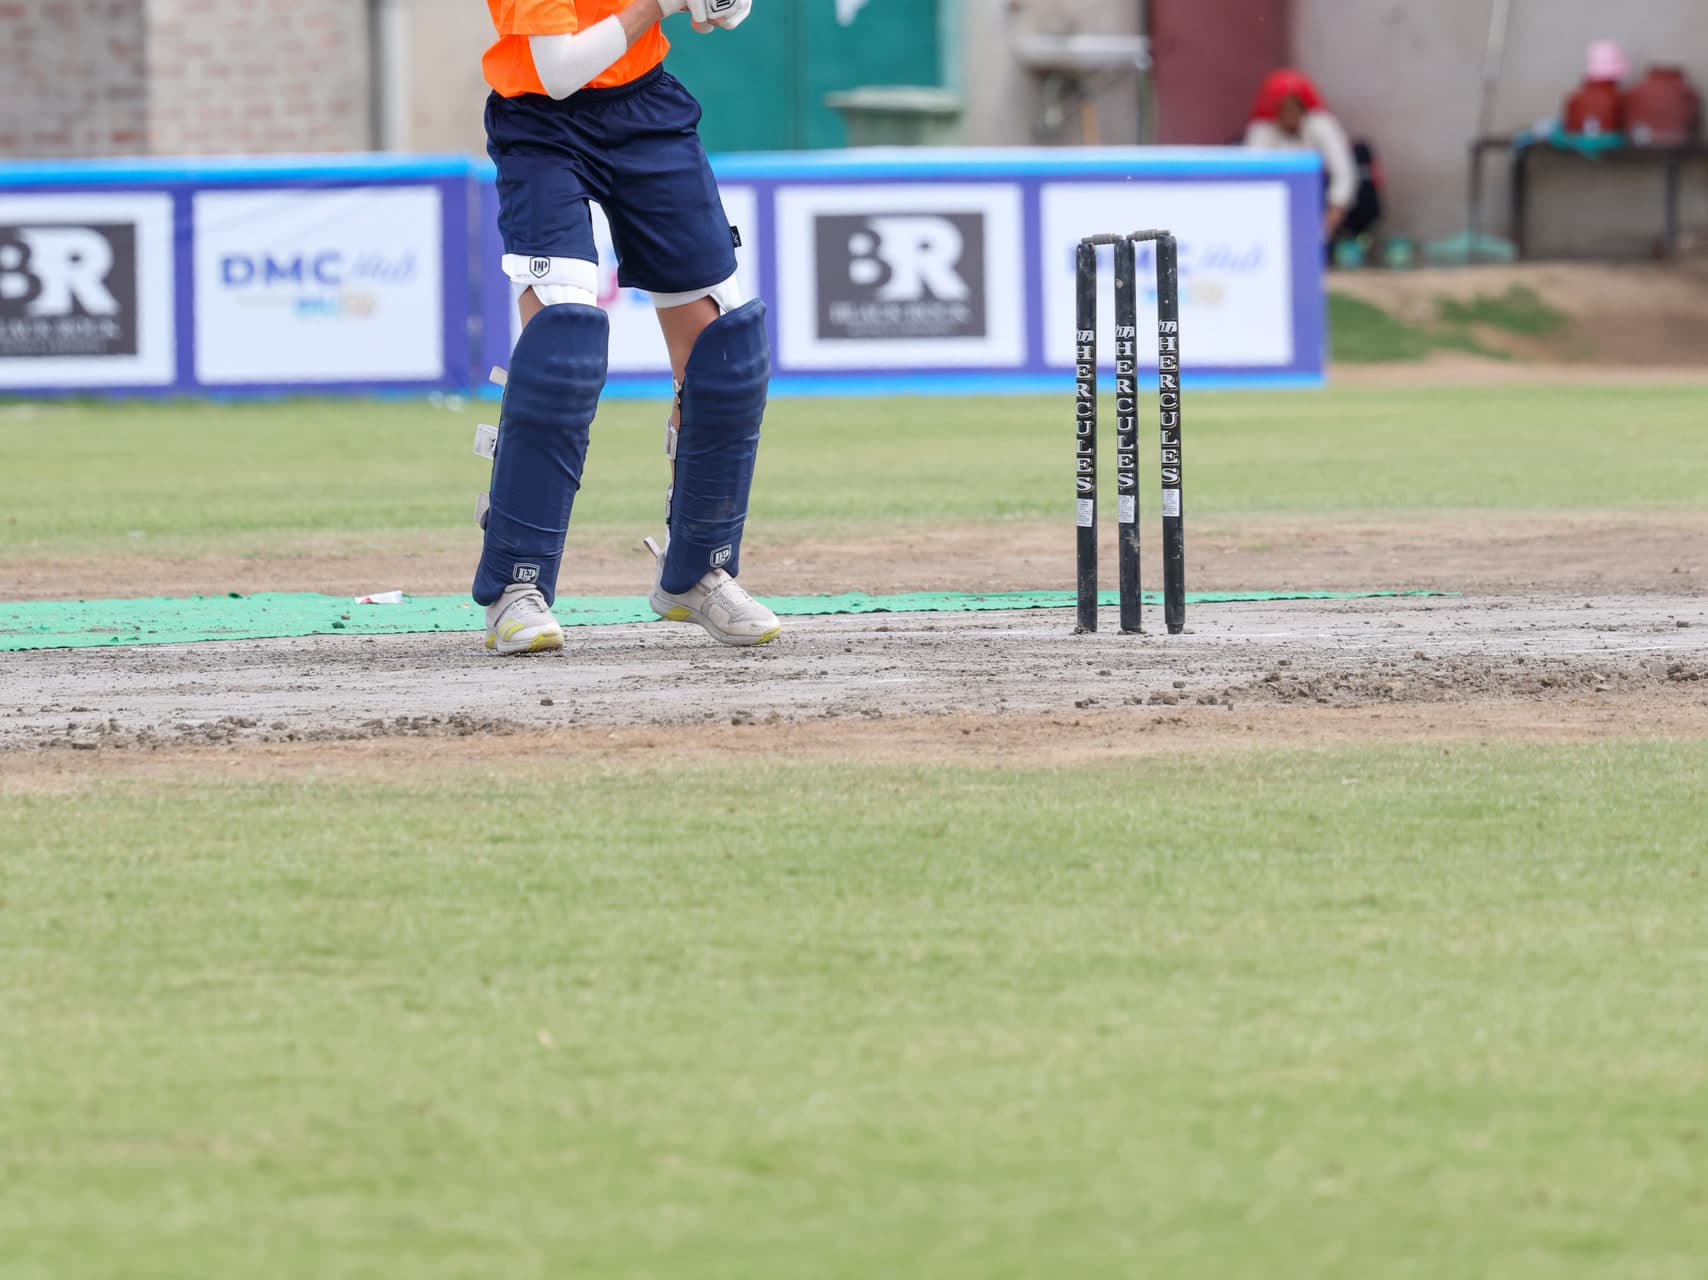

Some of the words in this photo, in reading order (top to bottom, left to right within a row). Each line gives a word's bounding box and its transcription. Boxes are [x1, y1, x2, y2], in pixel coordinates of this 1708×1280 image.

[0, 226, 122, 316] BR
[220, 251, 343, 288] DMC
[532, 260, 549, 273] DP
[847, 216, 972, 300] BR
[1076, 345, 1094, 494] HERCULES
[1116, 341, 1135, 491] HERCULES
[1159, 336, 1180, 485] HERCULES
